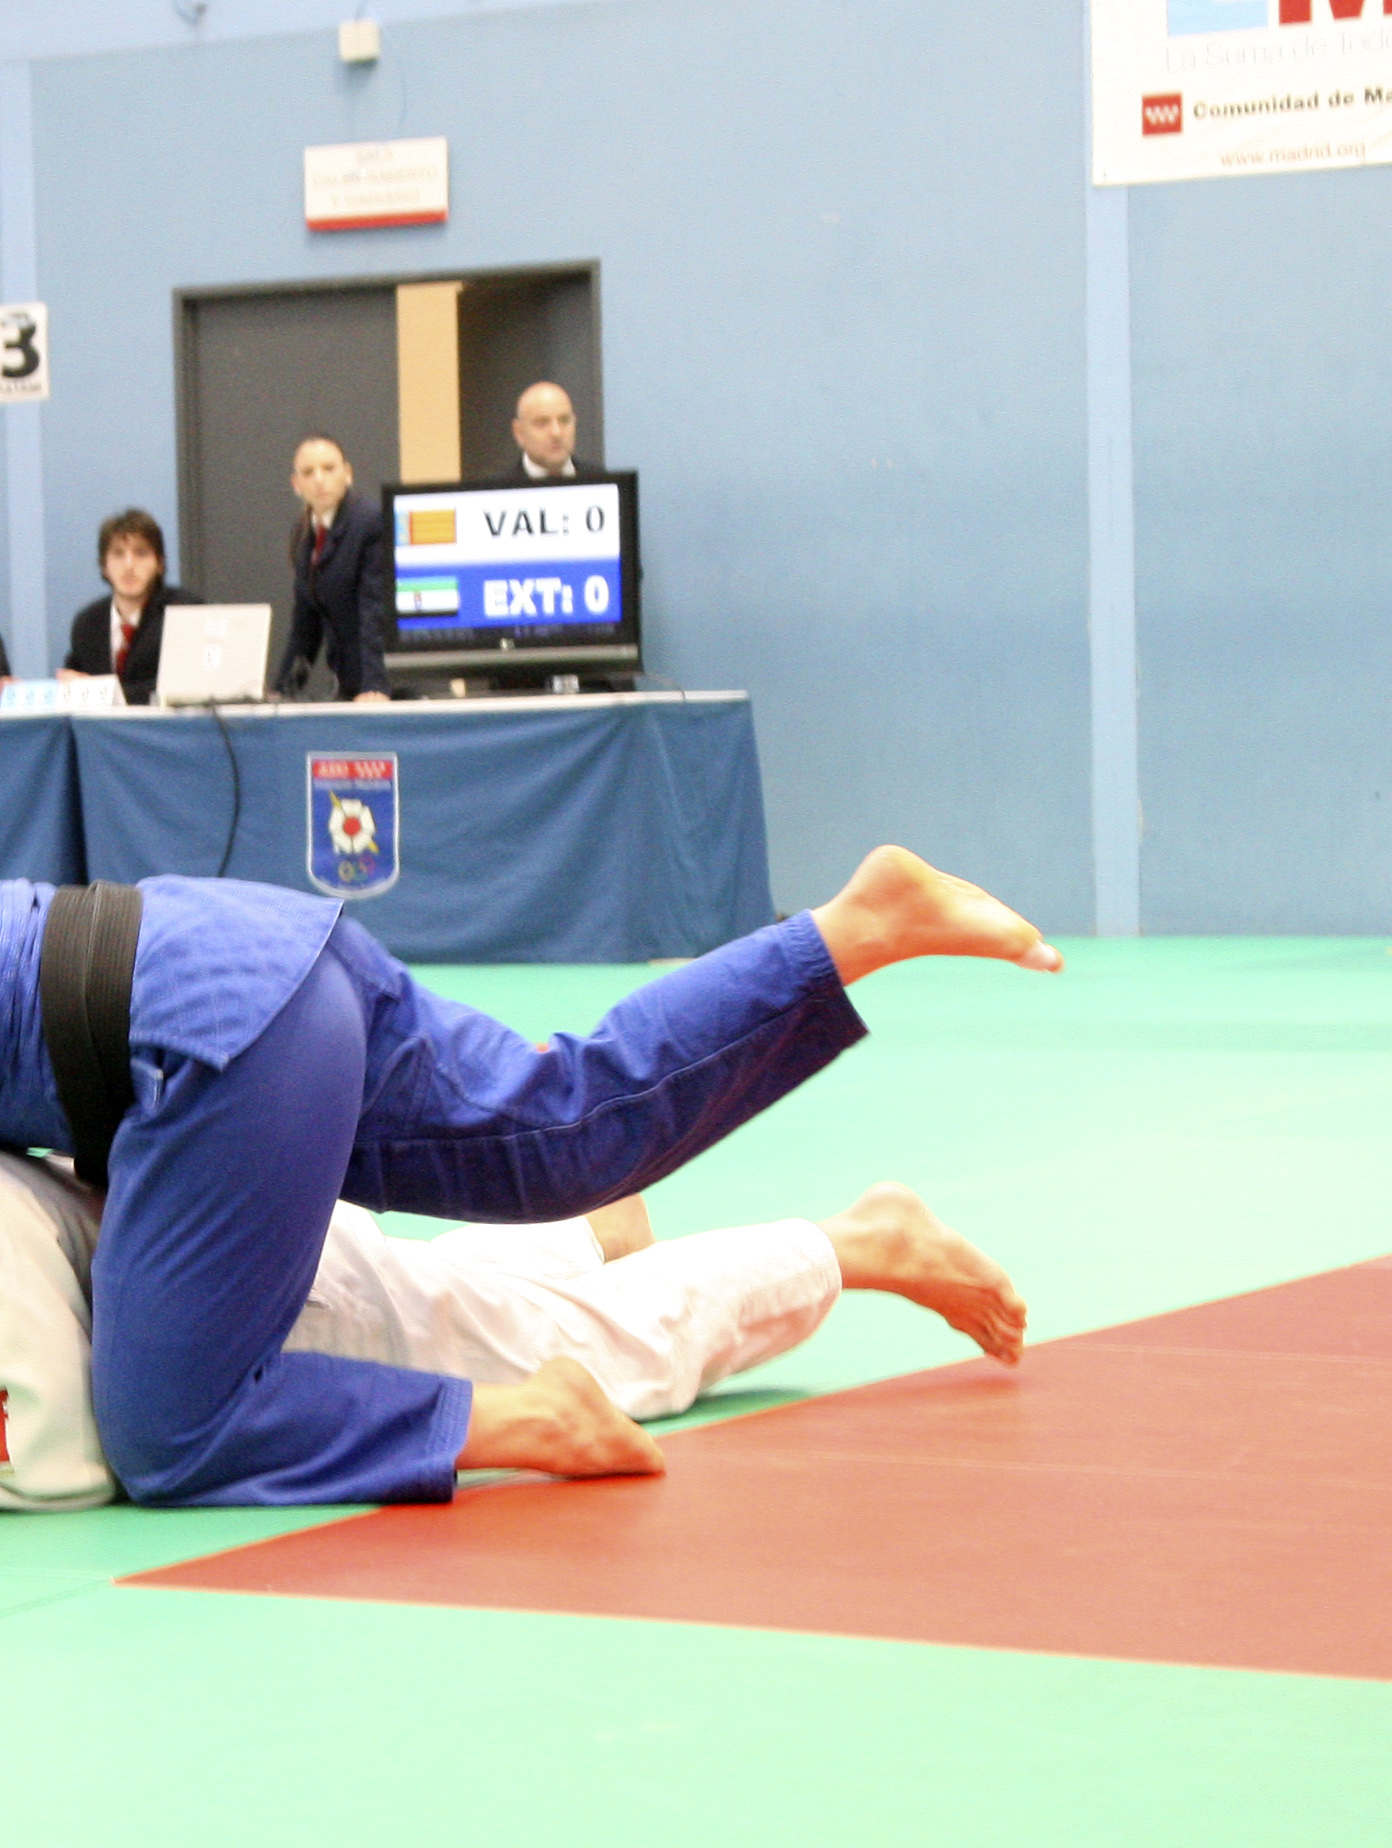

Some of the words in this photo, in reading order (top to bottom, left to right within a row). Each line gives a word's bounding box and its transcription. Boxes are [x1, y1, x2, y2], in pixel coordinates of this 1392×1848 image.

[1193, 90, 1320, 121] Comunidad
[1328, 89, 1356, 112] de
[0, 311, 40, 379] 3
[483, 506, 570, 538] VAL:
[585, 505, 606, 533] 0
[483, 576, 574, 618] EXT:
[584, 574, 609, 616] 0
